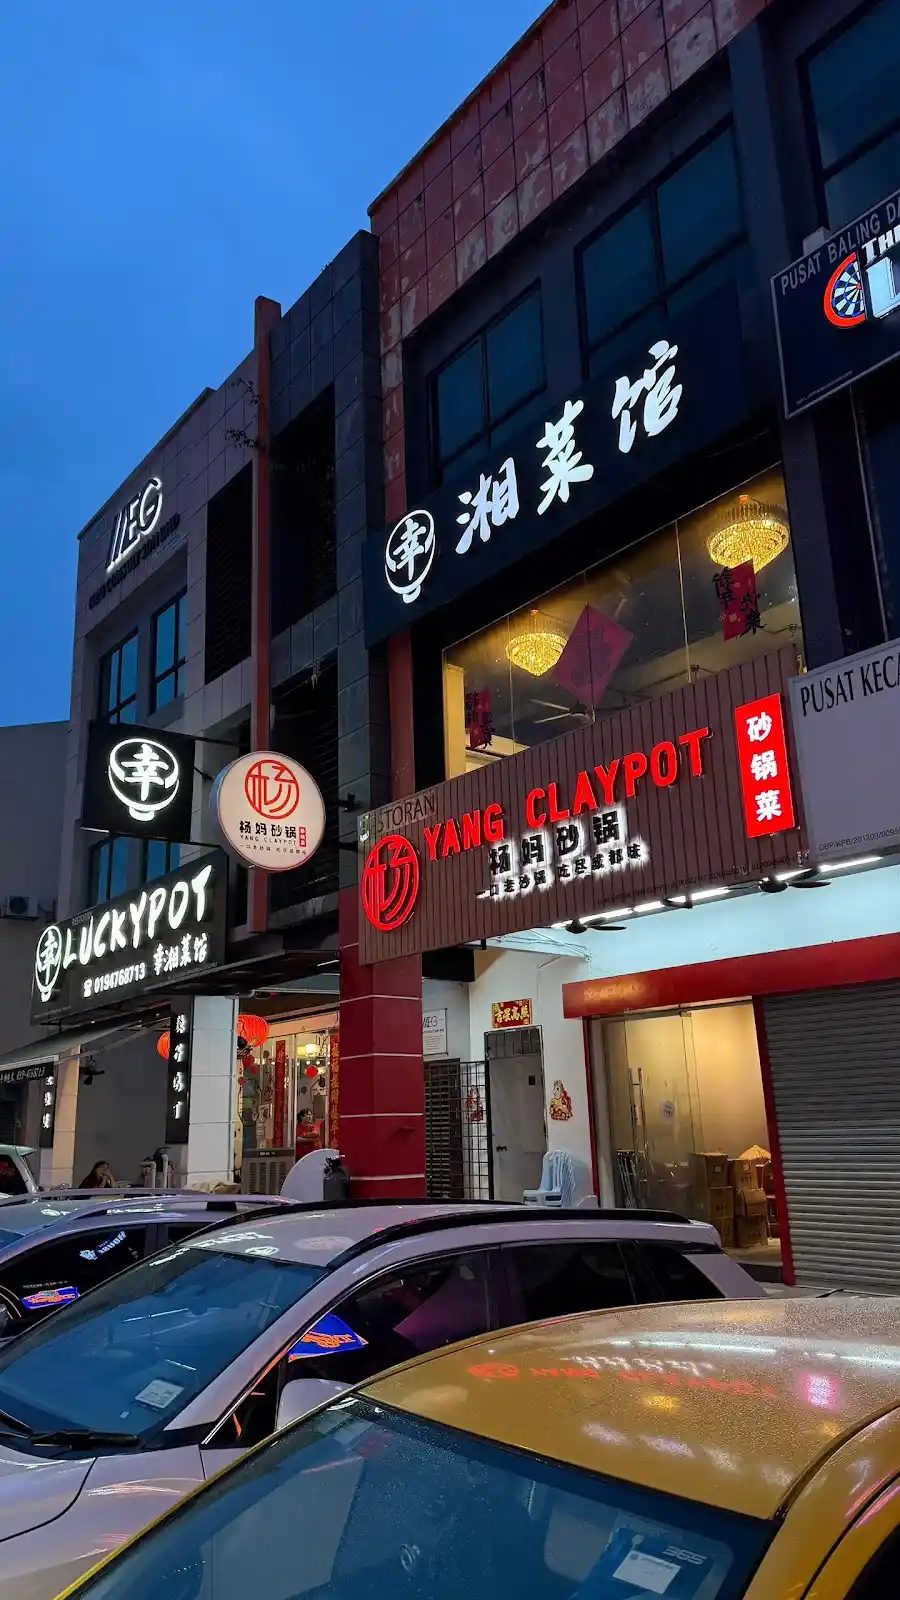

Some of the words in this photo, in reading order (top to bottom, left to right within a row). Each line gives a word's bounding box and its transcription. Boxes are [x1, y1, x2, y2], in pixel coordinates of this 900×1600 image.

[780, 252, 822, 295] PUSAT
[828, 213, 881, 264] BALING
[886, 195, 900, 225] D
[455, 339, 683, 555] 湘菜馆
[801, 669, 855, 717] PUSAT
[746, 711, 782, 822] 砂锅菜
[423, 804, 504, 861] YANG
[526, 727, 709, 828] CLAYPOT
[239, 821, 297, 839] 杨妈砂锅
[240, 834, 259, 842] YANG
[263, 837, 297, 846] CLAYPOT
[489, 810, 620, 875] 杨妈砂锅
[819, 826, 900, 851] DBP/KPB/201209/0095
[62, 865, 212, 969] LUCKYPOT
[94, 961, 146, 994] 0194768713
[153, 932, 208, 976] 幸湘菜馆
[661, 1545, 708, 1565] 365
